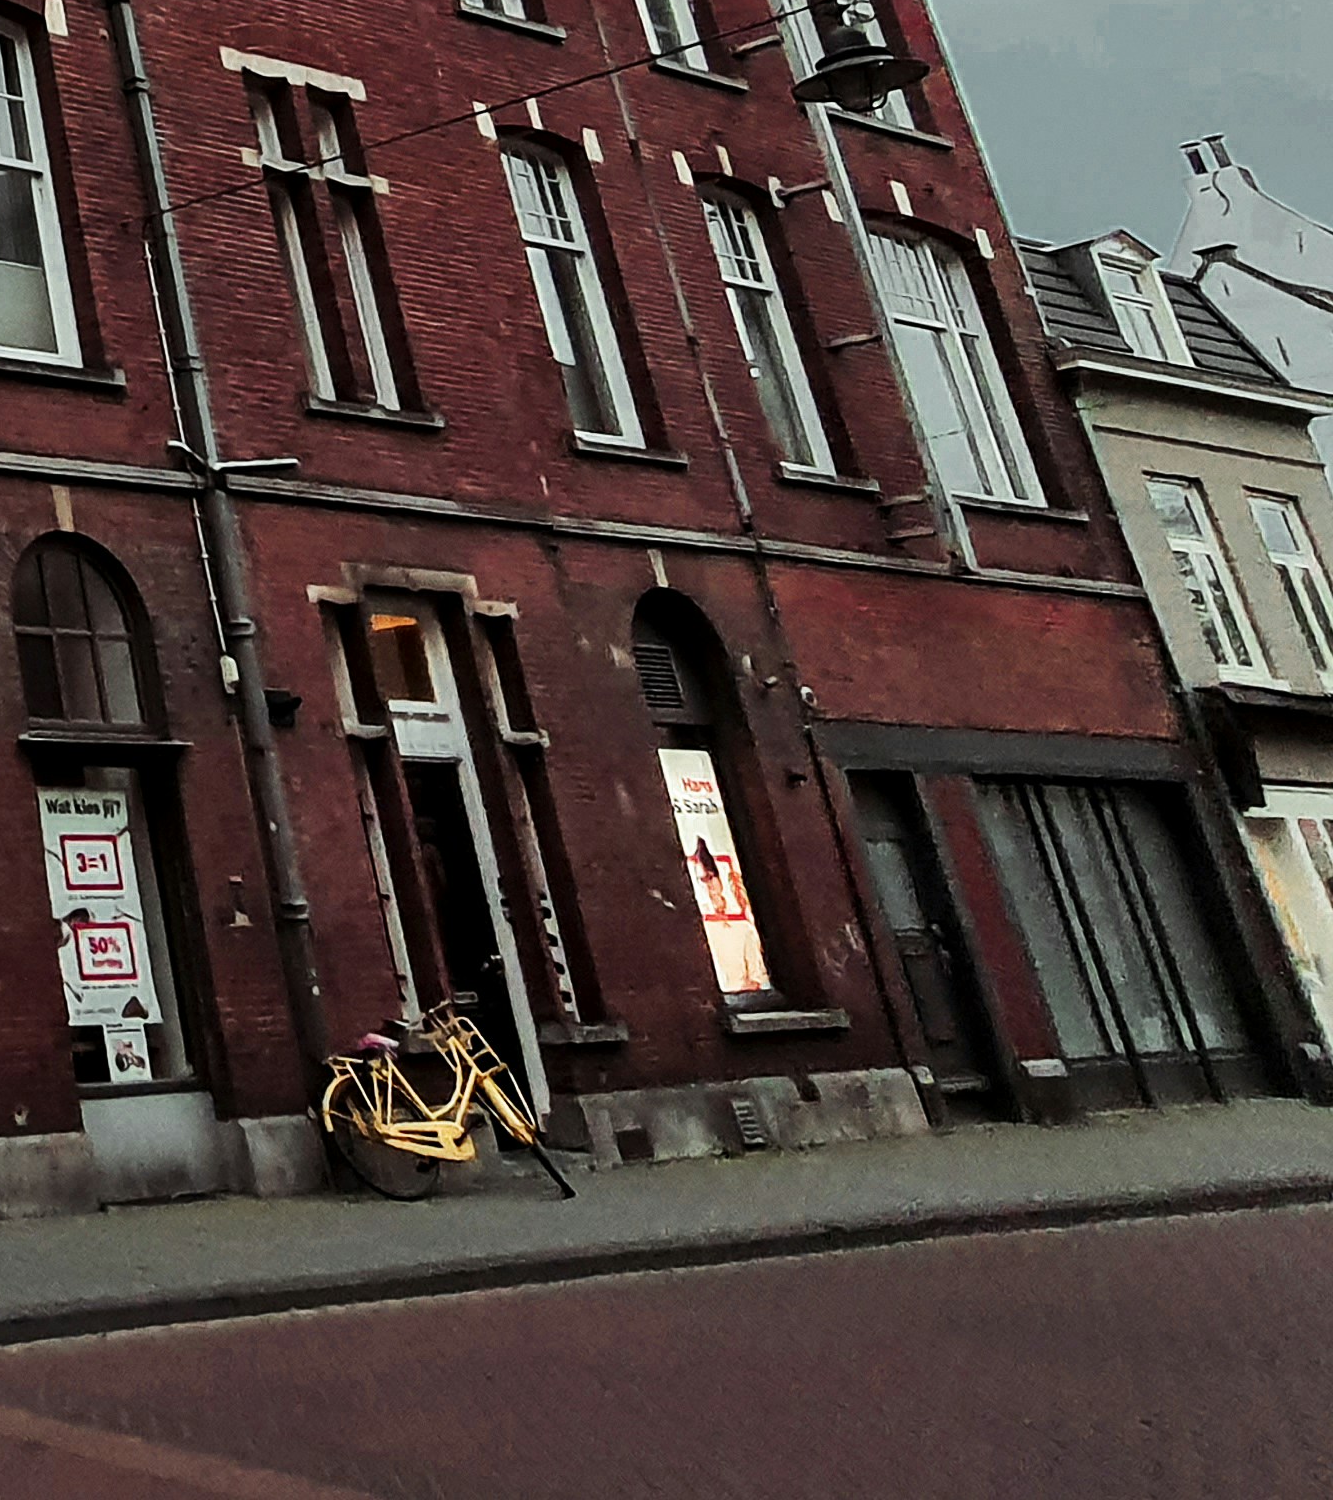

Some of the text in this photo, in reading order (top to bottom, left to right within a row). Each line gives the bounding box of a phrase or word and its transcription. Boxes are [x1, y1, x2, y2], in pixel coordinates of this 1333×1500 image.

[44, 798, 71, 814] Wat
[76, 852, 108, 873] 3=1
[87, 936, 121, 955] 50%
